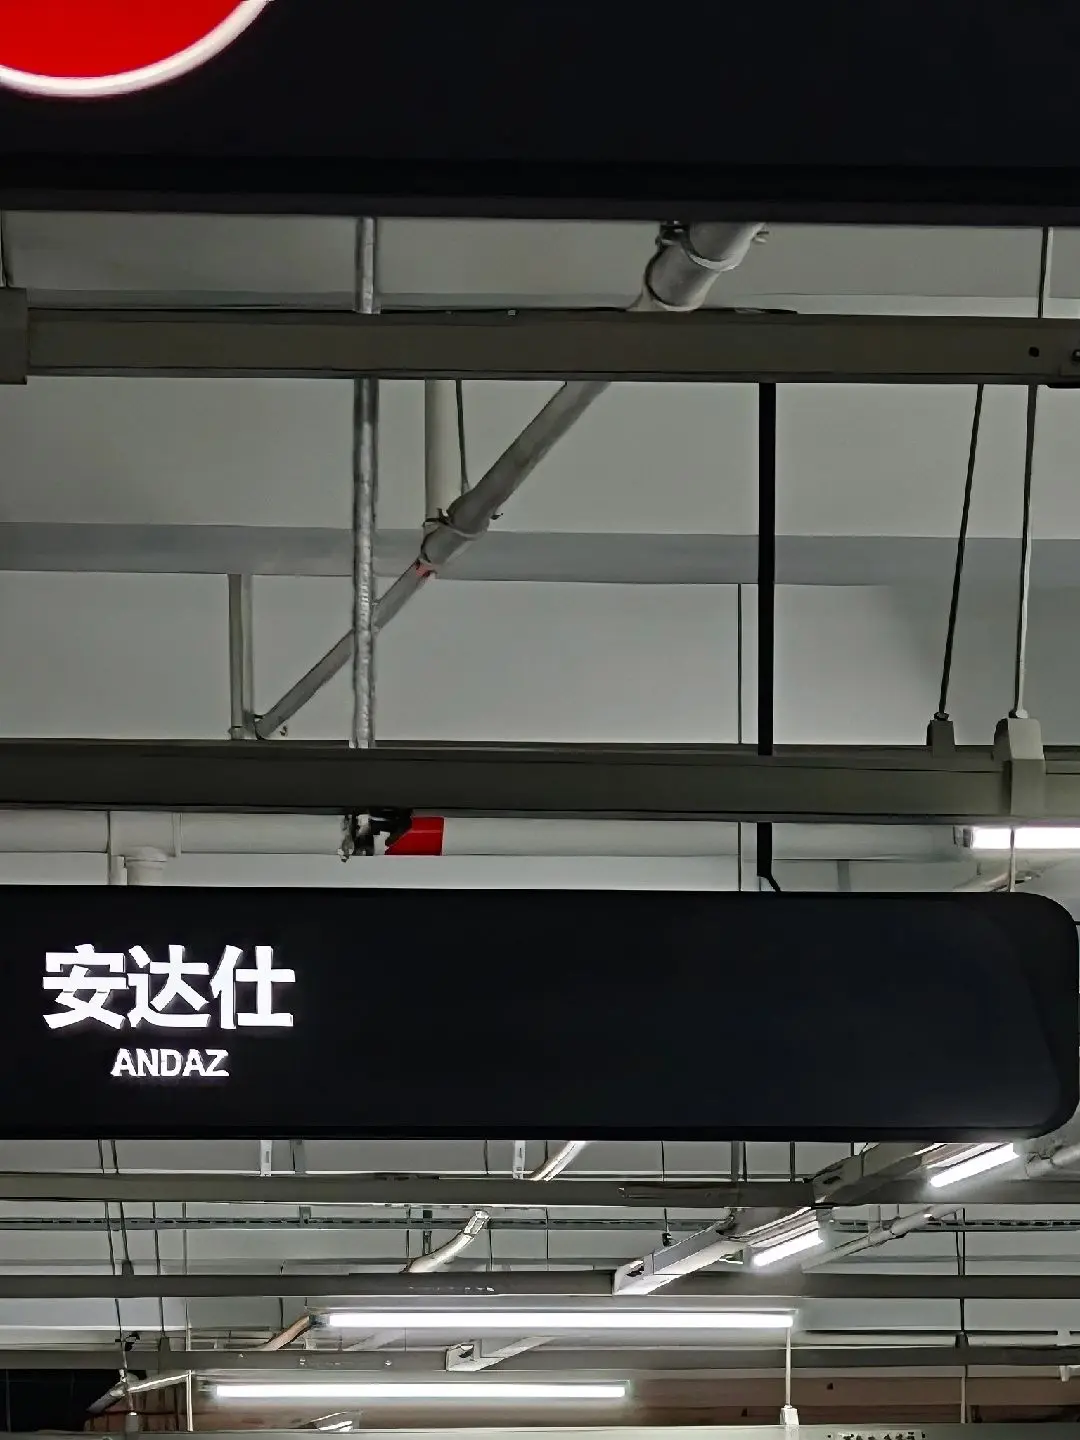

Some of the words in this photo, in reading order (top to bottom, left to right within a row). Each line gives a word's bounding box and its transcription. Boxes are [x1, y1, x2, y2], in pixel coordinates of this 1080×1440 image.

[42, 943, 296, 1030] 安达仕
[110, 1048, 230, 1077] ANDAZ
